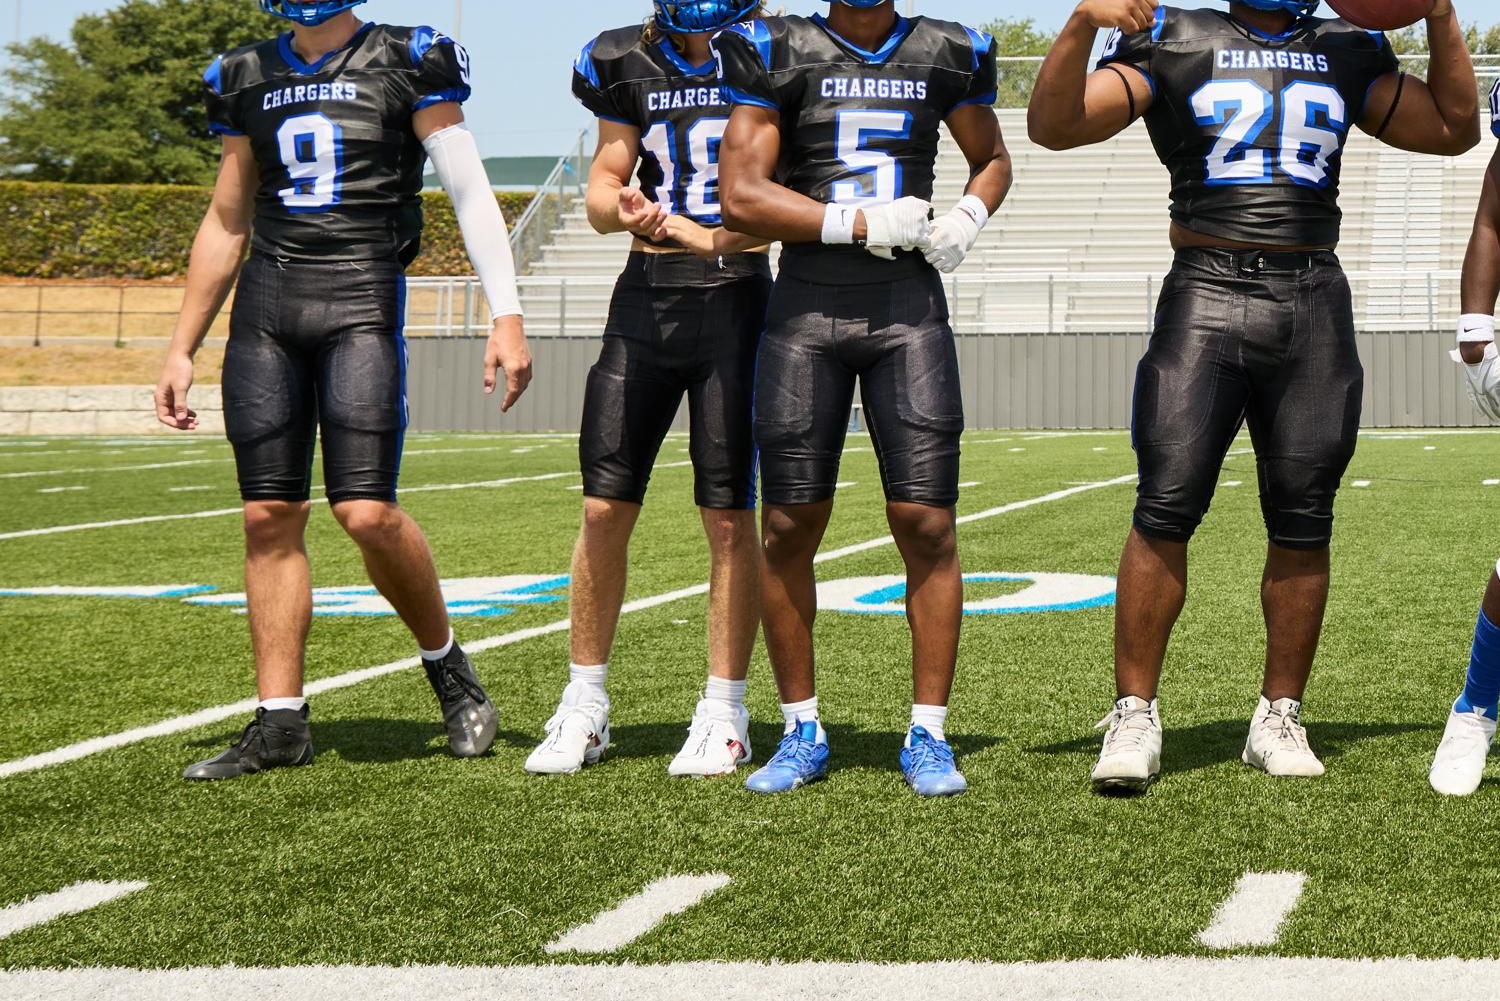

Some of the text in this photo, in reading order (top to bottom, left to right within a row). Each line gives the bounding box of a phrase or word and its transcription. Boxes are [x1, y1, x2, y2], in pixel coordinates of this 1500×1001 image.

[453, 43, 471, 86] 9
[1216, 49, 1328, 72] CHARGERS
[262, 82, 358, 112] CHARGERS
[647, 86, 729, 111] CHARGE
[820, 77, 927, 101] CHARGERS
[1188, 78, 1348, 189] 26
[273, 110, 343, 214] 9
[830, 108, 915, 208] 5
